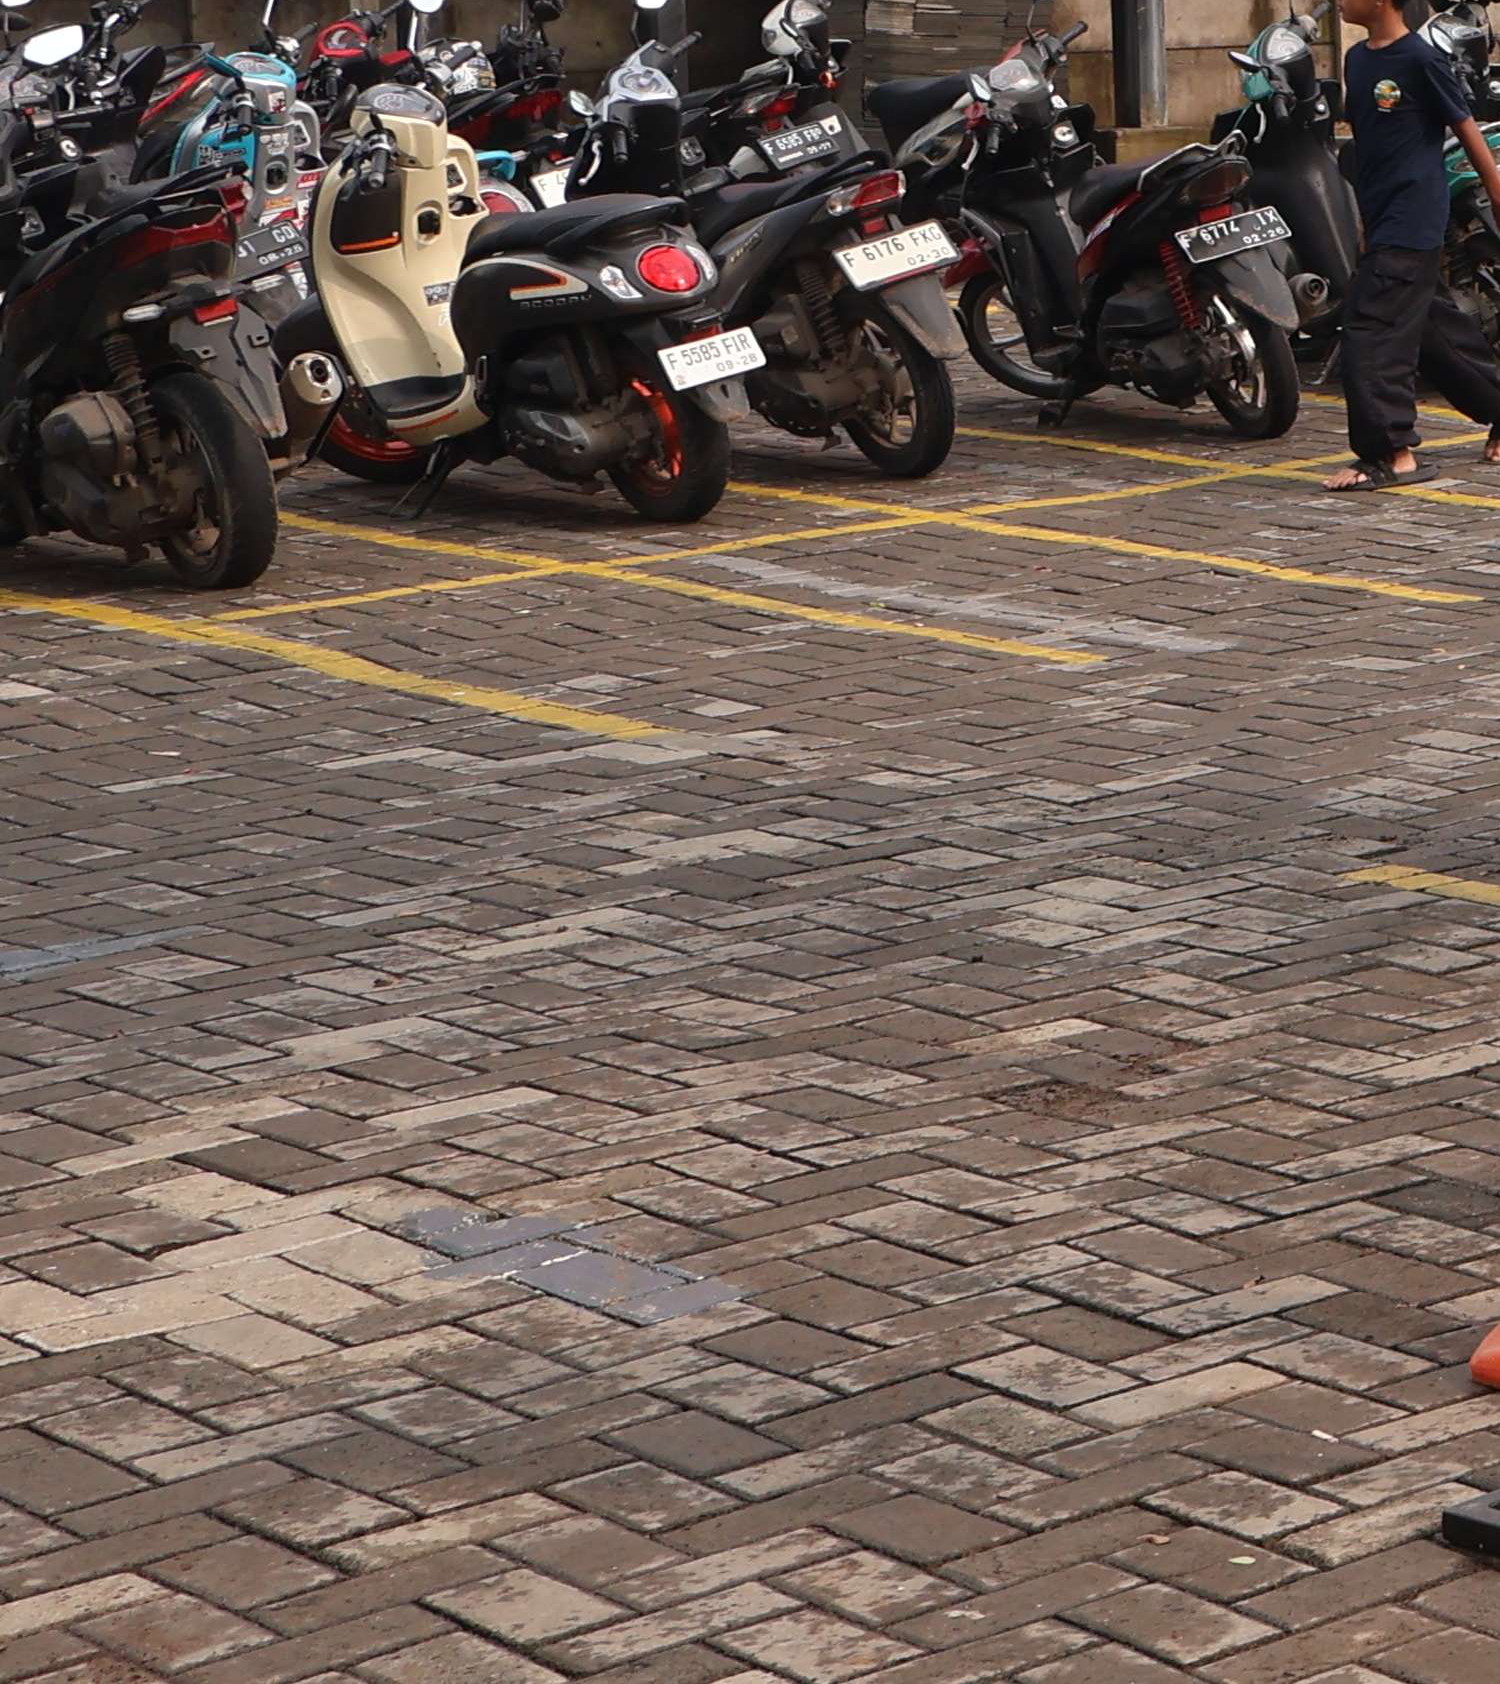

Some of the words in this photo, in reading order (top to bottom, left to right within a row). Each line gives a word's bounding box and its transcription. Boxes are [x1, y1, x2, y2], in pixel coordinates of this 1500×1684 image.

[842, 252, 855, 268] F
[861, 237, 905, 261] 6176
[666, 353, 678, 370] F
[680, 341, 721, 366] 5585
[721, 333, 752, 355] FIR
